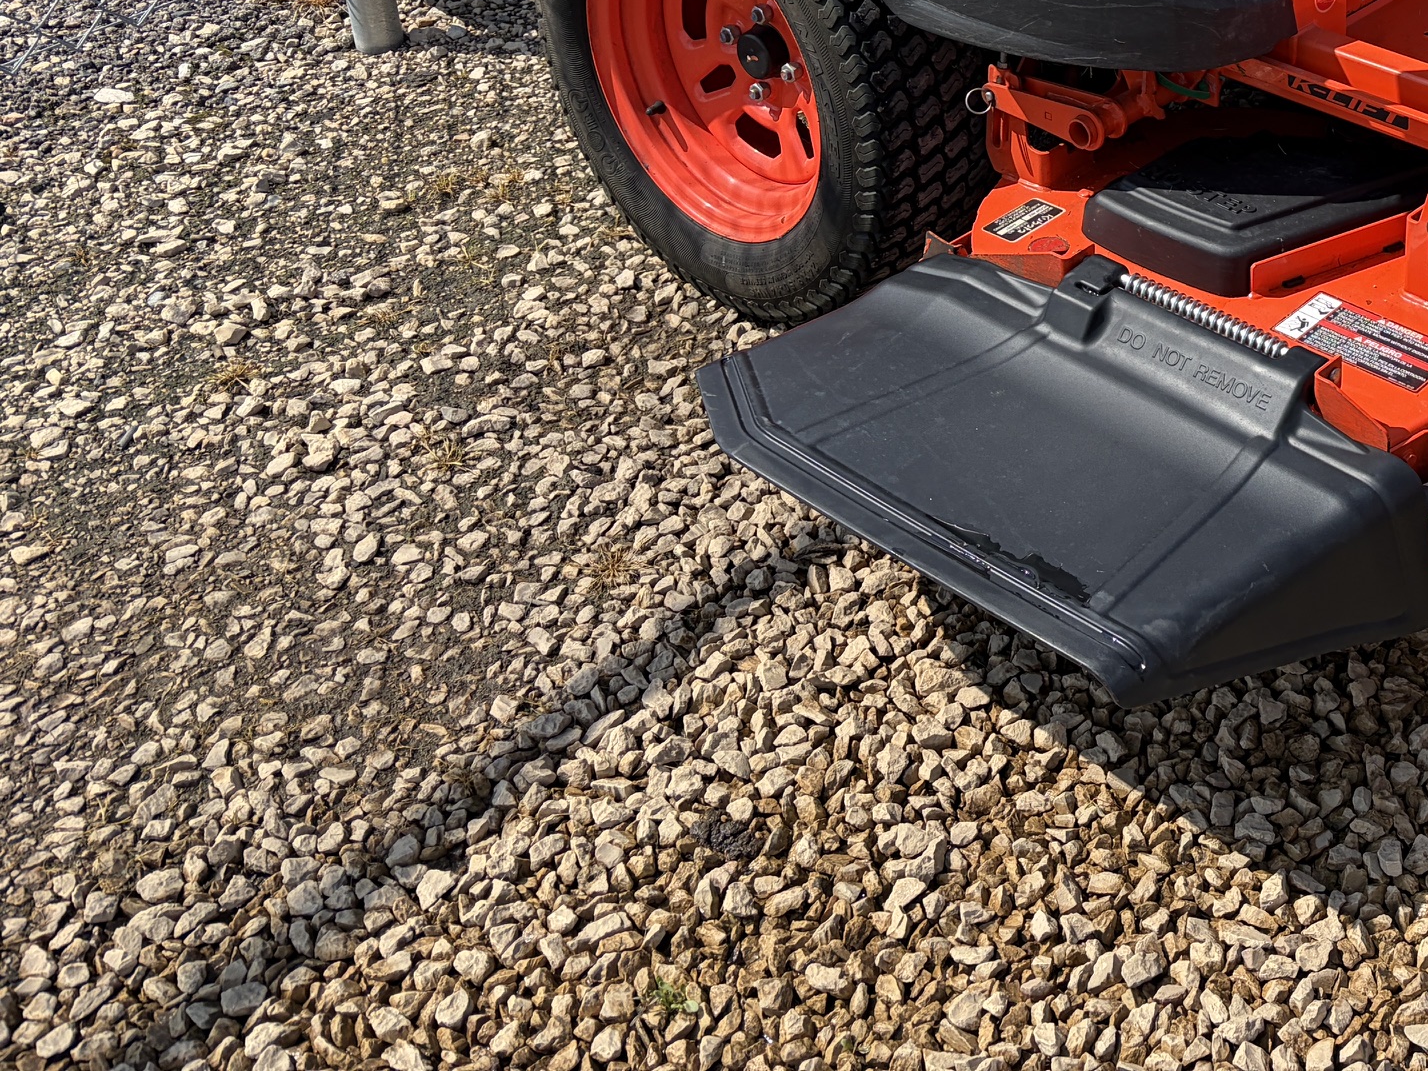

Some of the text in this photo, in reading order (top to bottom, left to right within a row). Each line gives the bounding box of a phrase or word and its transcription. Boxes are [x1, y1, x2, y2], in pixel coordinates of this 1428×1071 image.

[1186, 182, 1258, 215] STEP
[1017, 213, 1054, 234] Kubota
[1385, 320, 1424, 340] DANGER
[1363, 338, 1403, 359] PELIGRO
[1116, 327, 1273, 411] DO NOT REMOVE
